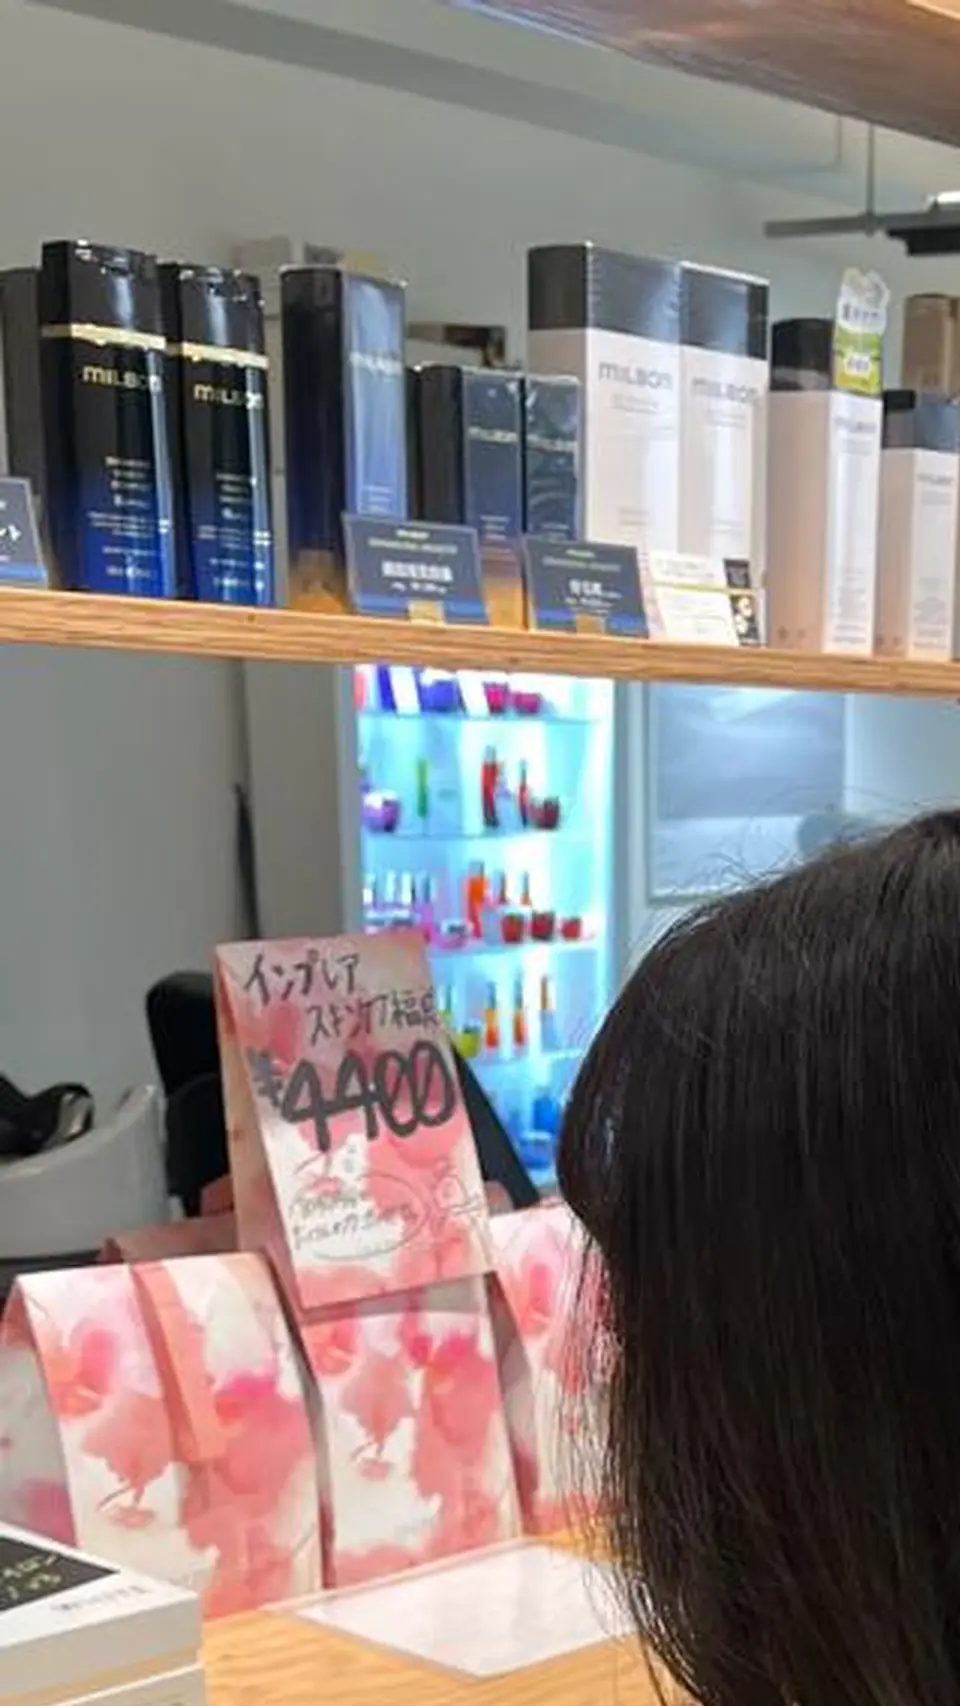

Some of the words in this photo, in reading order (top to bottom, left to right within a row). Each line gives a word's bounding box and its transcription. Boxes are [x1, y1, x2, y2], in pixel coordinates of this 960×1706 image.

[242, 949, 360, 1006] インプレア
